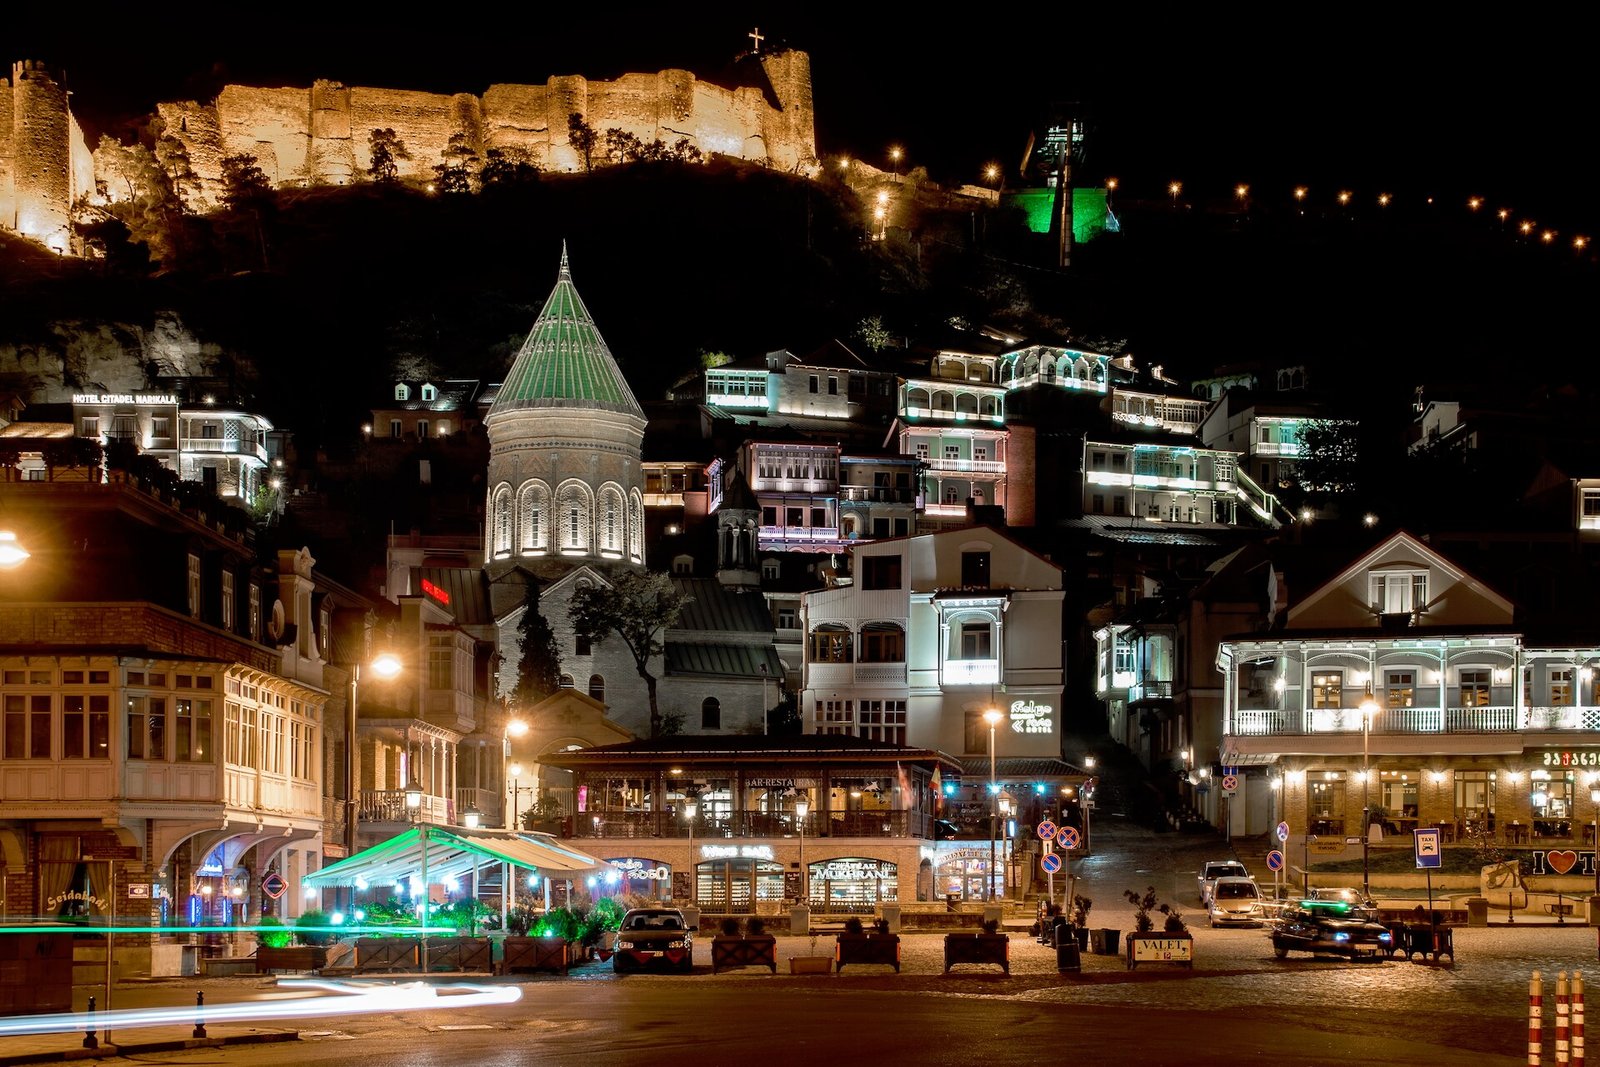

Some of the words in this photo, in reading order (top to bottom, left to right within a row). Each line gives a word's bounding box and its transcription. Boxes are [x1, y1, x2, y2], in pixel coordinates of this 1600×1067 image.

[73, 394, 100, 404] HOTEL
[101, 394, 135, 404] CITADEL
[136, 394, 176, 404] NARIKALA
[1543, 752, 1600, 766] მაჭახე
[1533, 851, 1545, 875] I
[814, 868, 889, 879] MUKHRANI
[47, 889, 109, 911] Seidabadi
[1143, 940, 1183, 950] VALET
